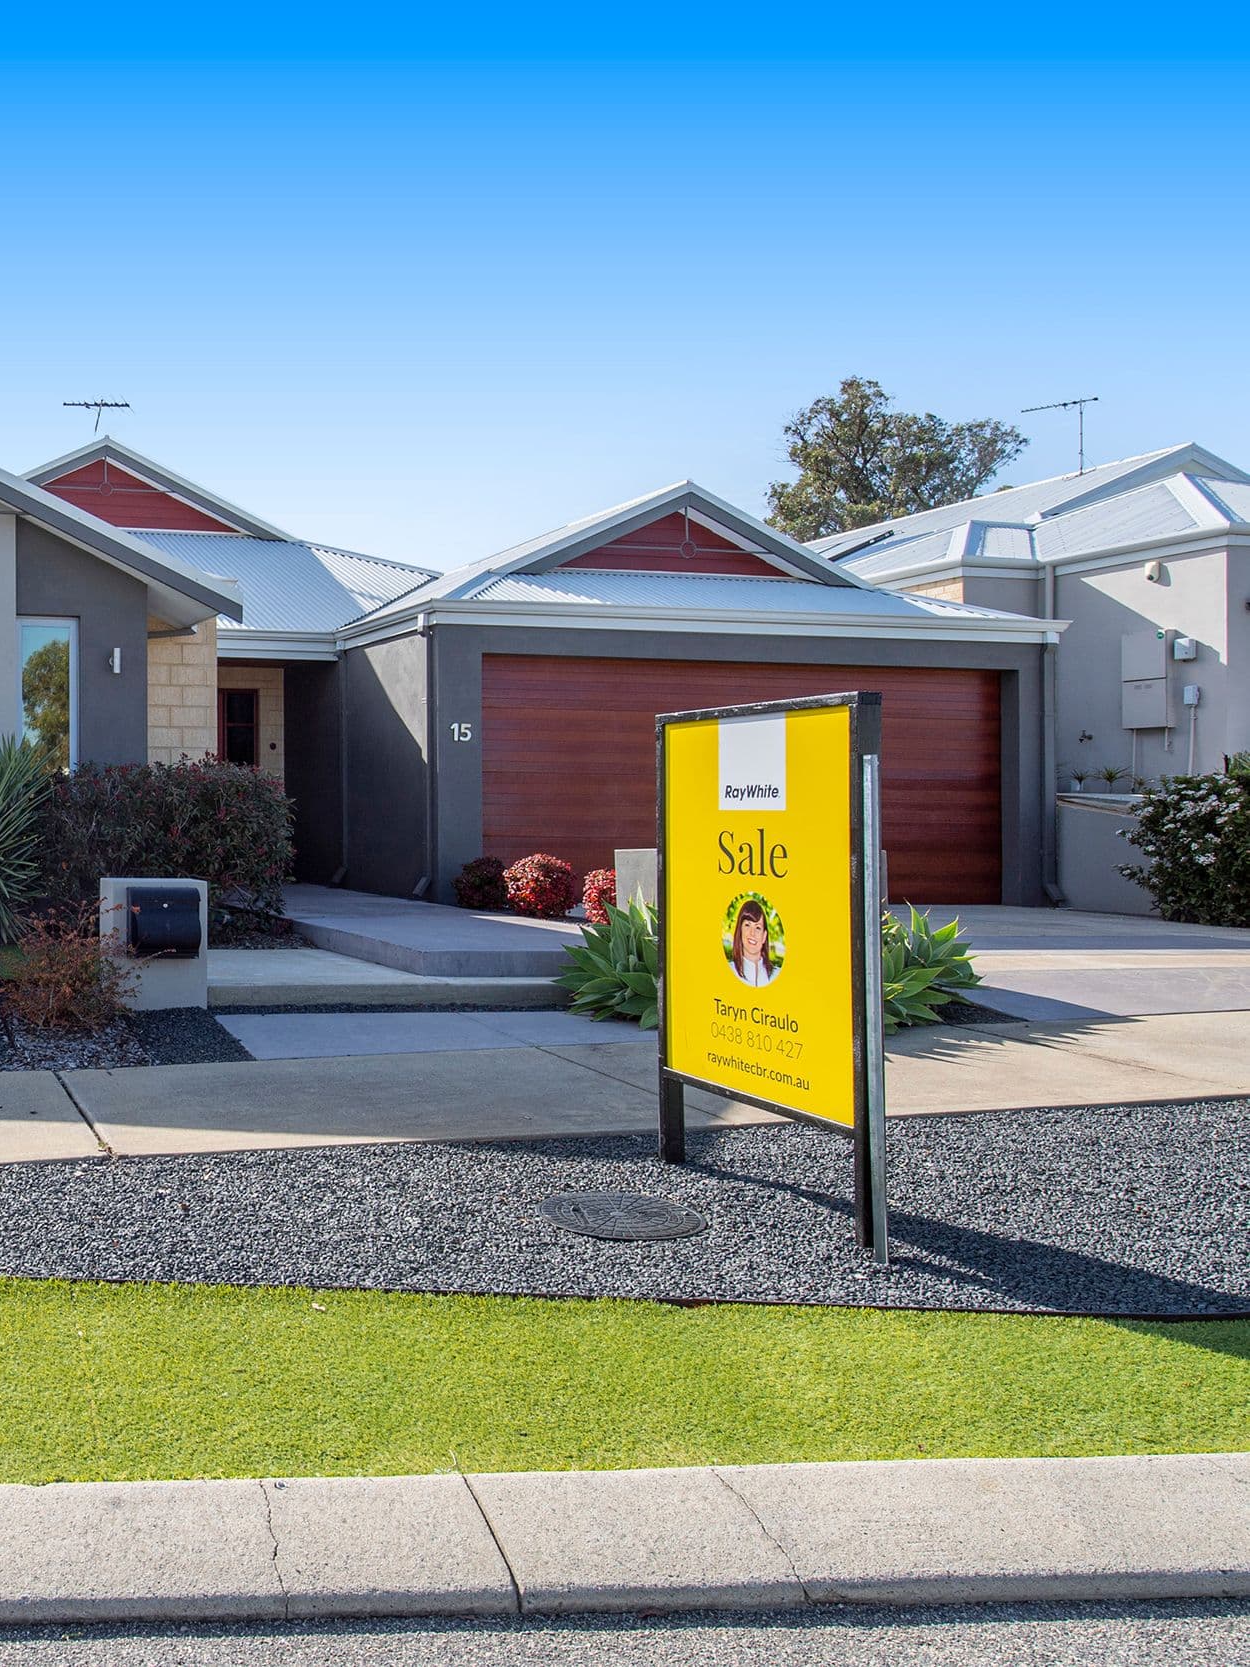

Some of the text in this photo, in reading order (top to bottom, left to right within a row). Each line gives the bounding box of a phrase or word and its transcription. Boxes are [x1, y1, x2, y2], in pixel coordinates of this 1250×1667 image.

[450, 723, 472, 741] 15
[718, 828, 788, 878] Sale
[714, 998, 798, 1032] Taryn Ciraulo
[711, 1021, 803, 1060] 0438 810 427
[707, 1051, 810, 1090] raywhitecbr.com.au
